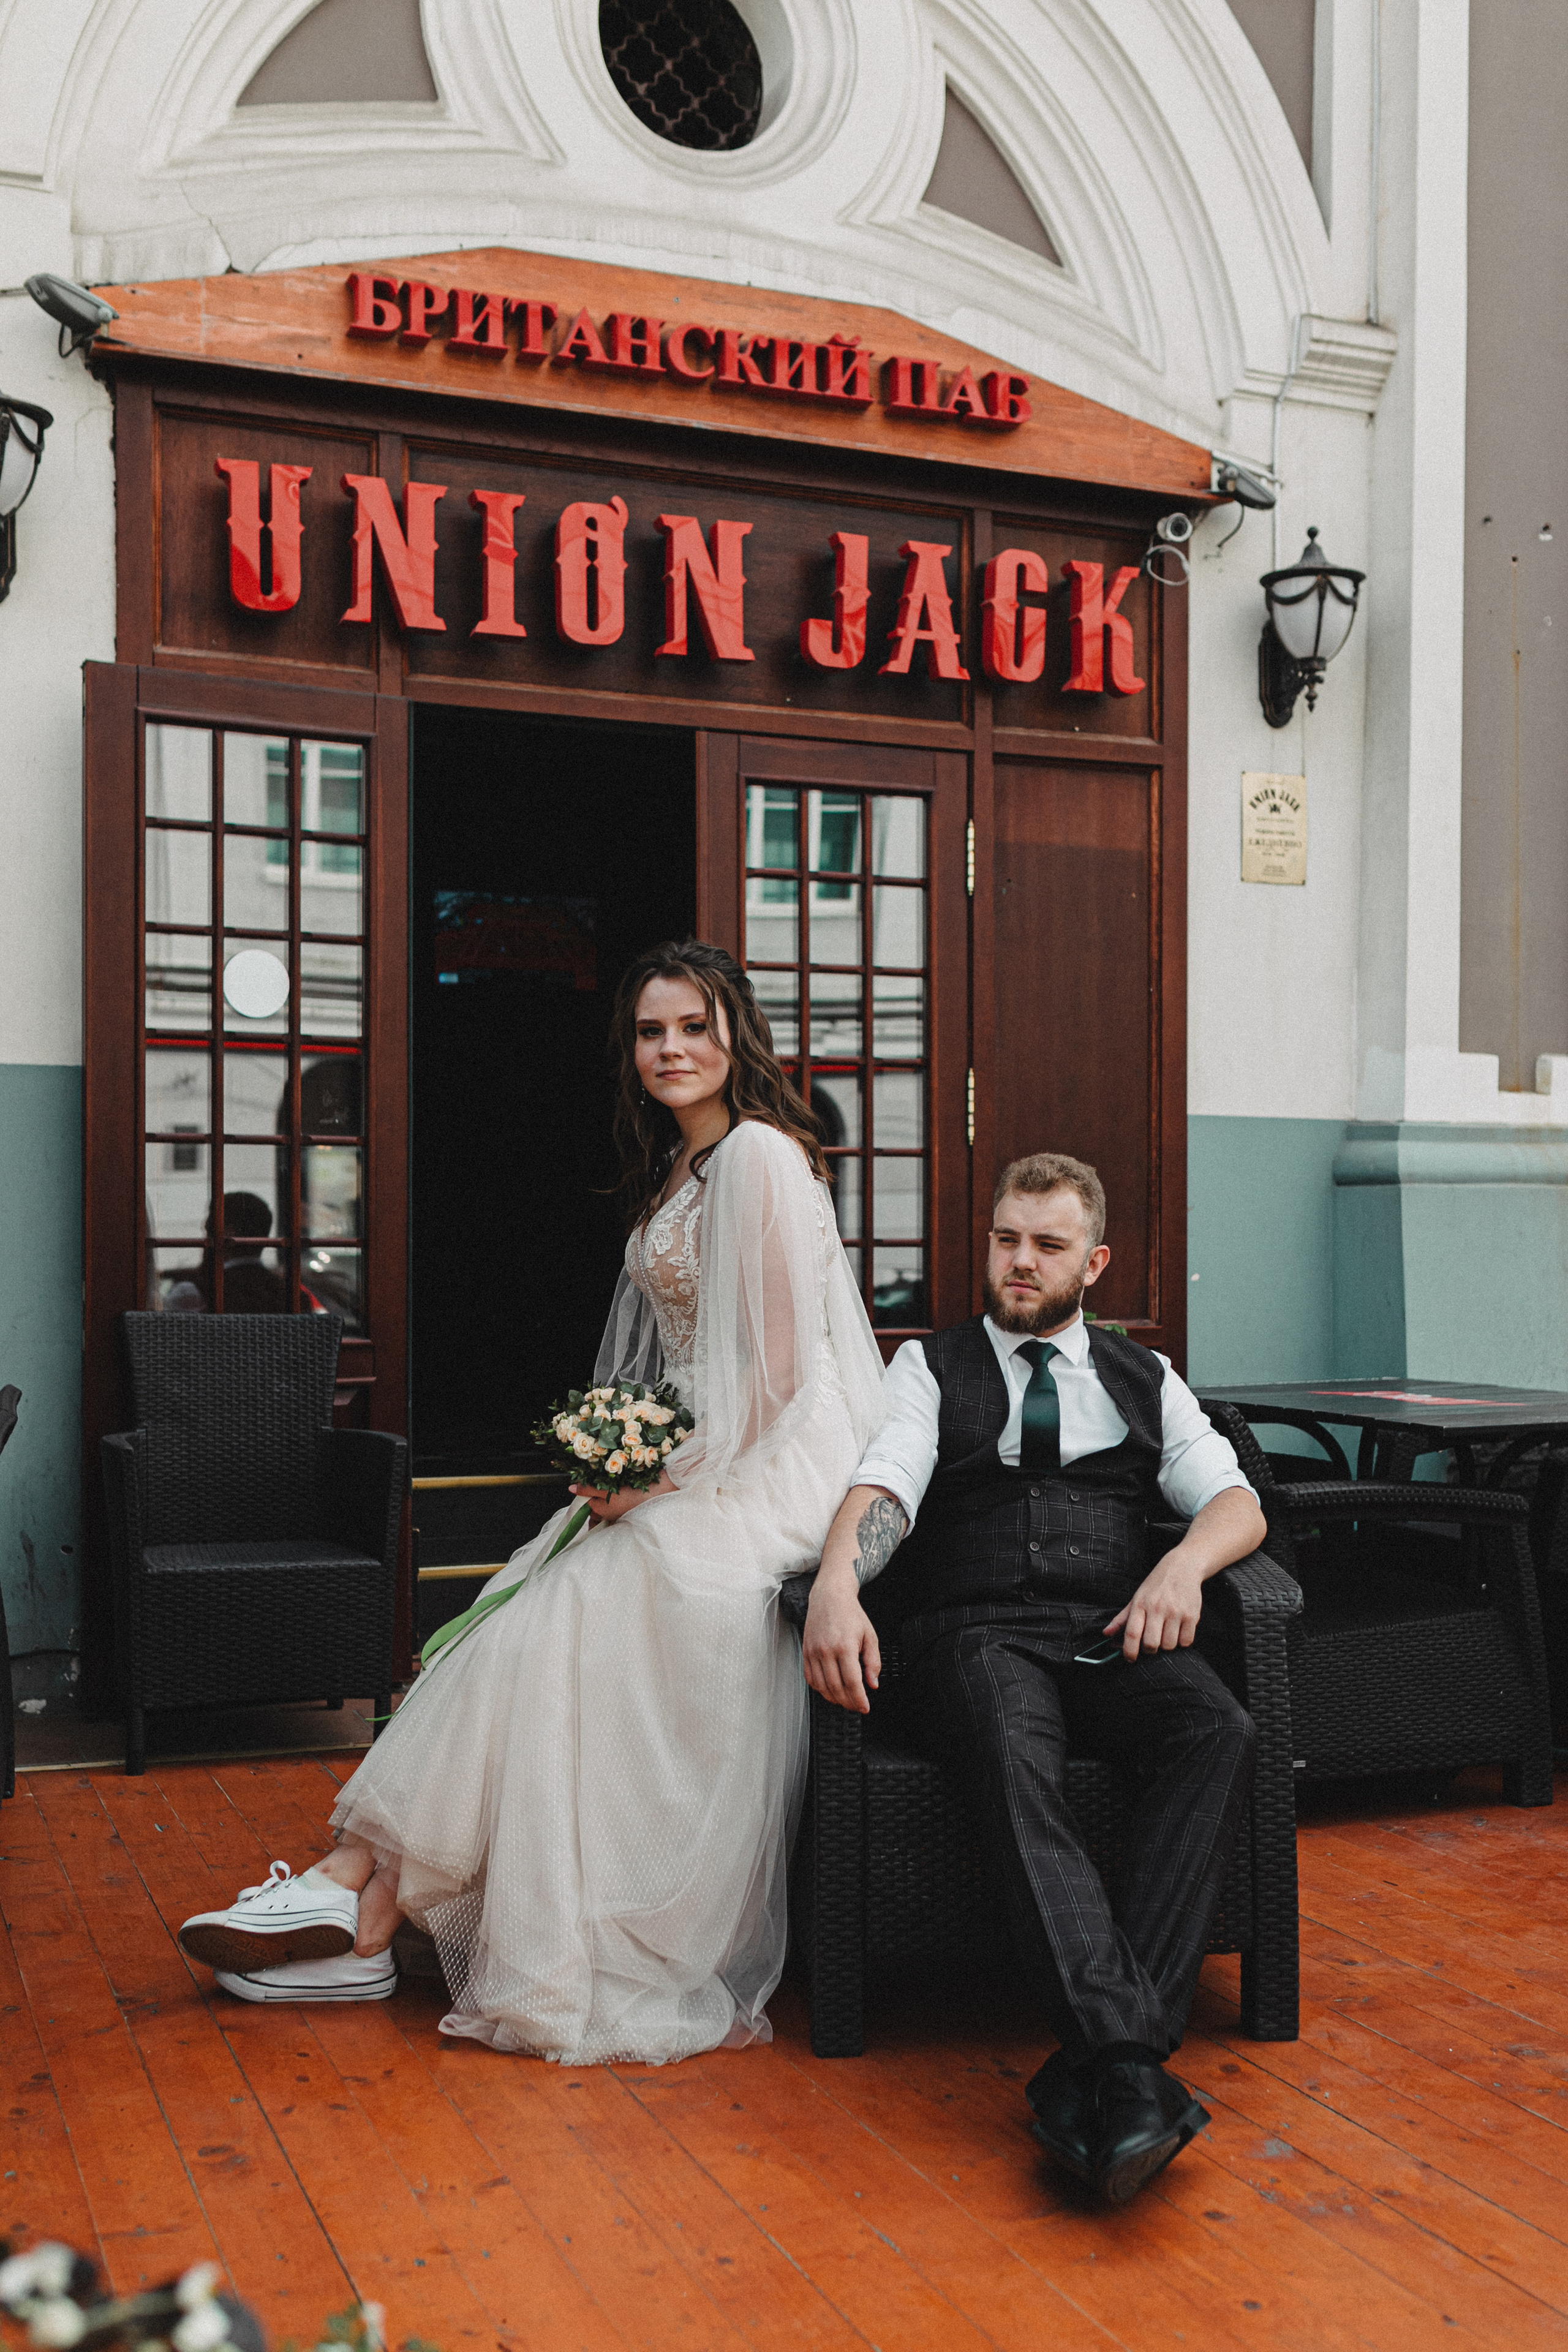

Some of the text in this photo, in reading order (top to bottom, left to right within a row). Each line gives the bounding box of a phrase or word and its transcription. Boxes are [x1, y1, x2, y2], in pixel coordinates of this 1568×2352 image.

[347, 272, 1033, 426] БРИТАНСКИЙ ПАБ
[214, 457, 1147, 696] UNION JACK
